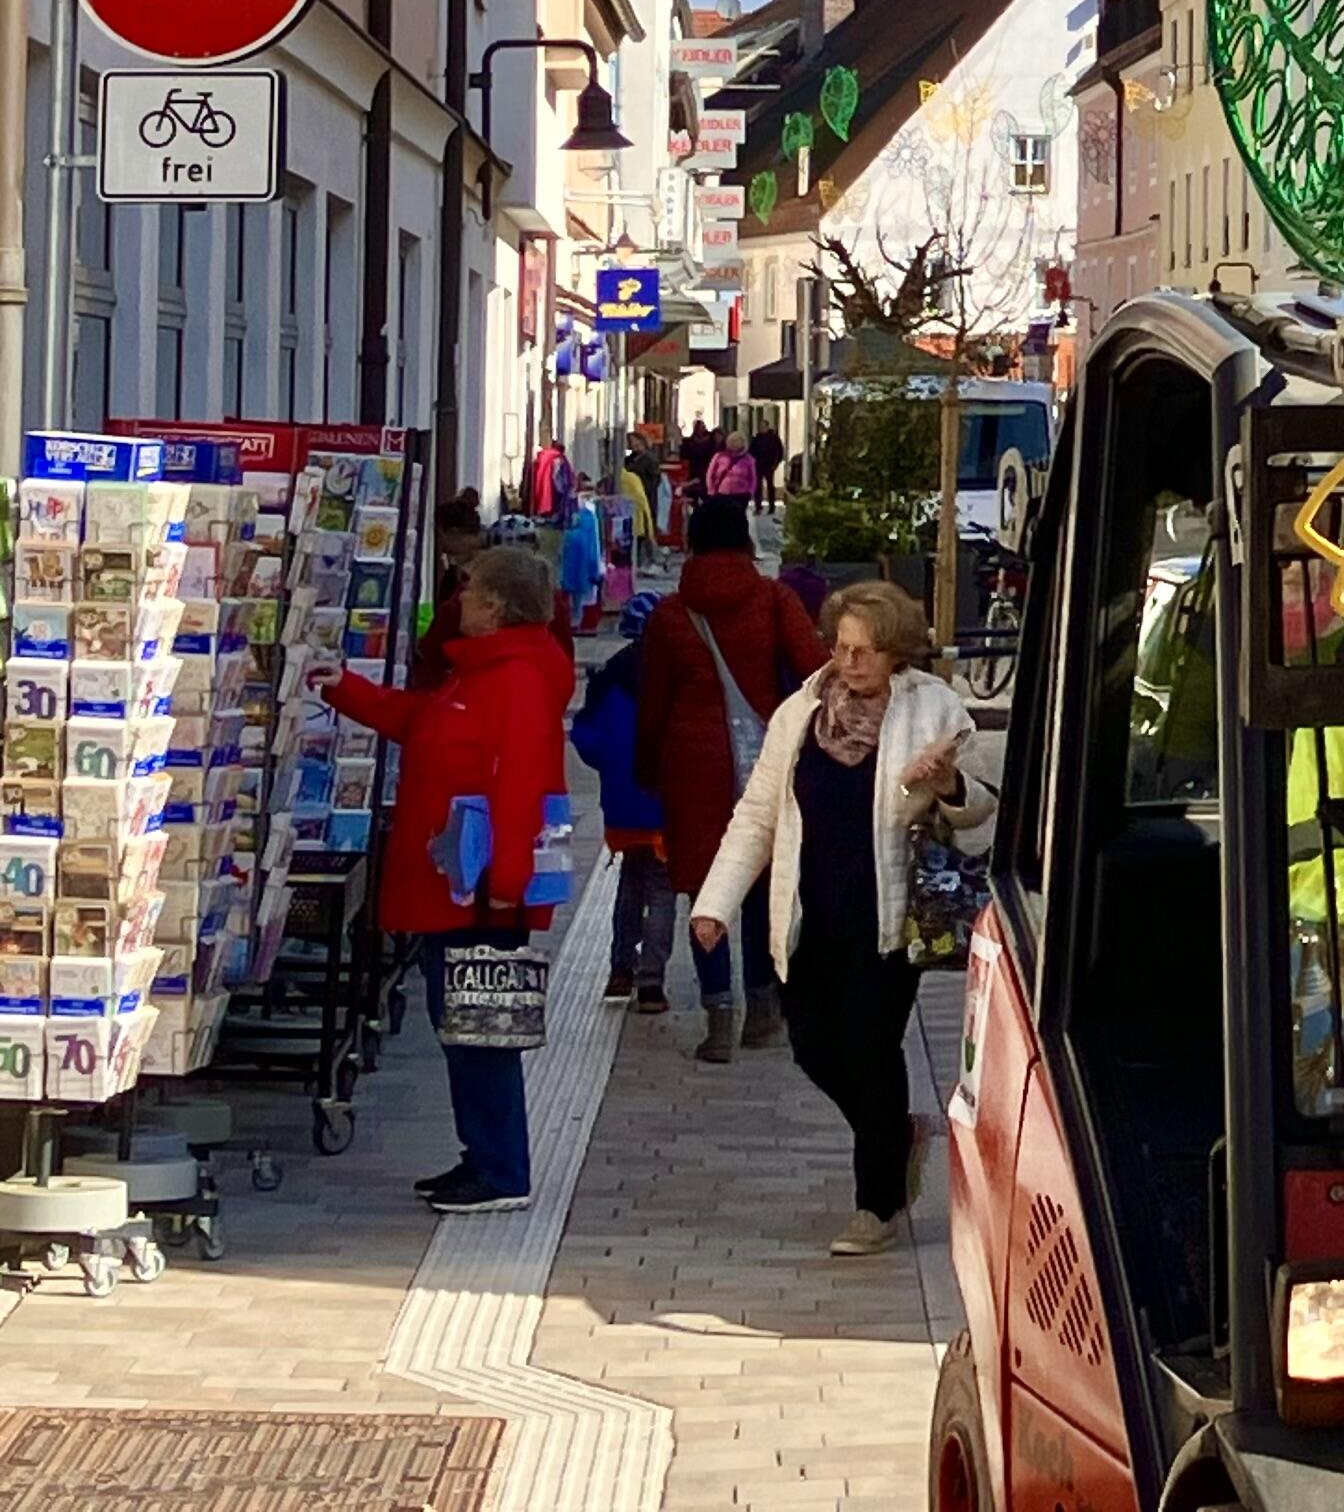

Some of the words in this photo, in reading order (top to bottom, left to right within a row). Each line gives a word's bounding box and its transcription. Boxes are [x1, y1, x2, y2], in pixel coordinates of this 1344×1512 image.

[161, 156, 214, 183] frei
[14, 679, 57, 720] 30
[74, 739, 118, 780] 60
[1, 855, 45, 897] 40
[55, 1033, 97, 1076] 70
